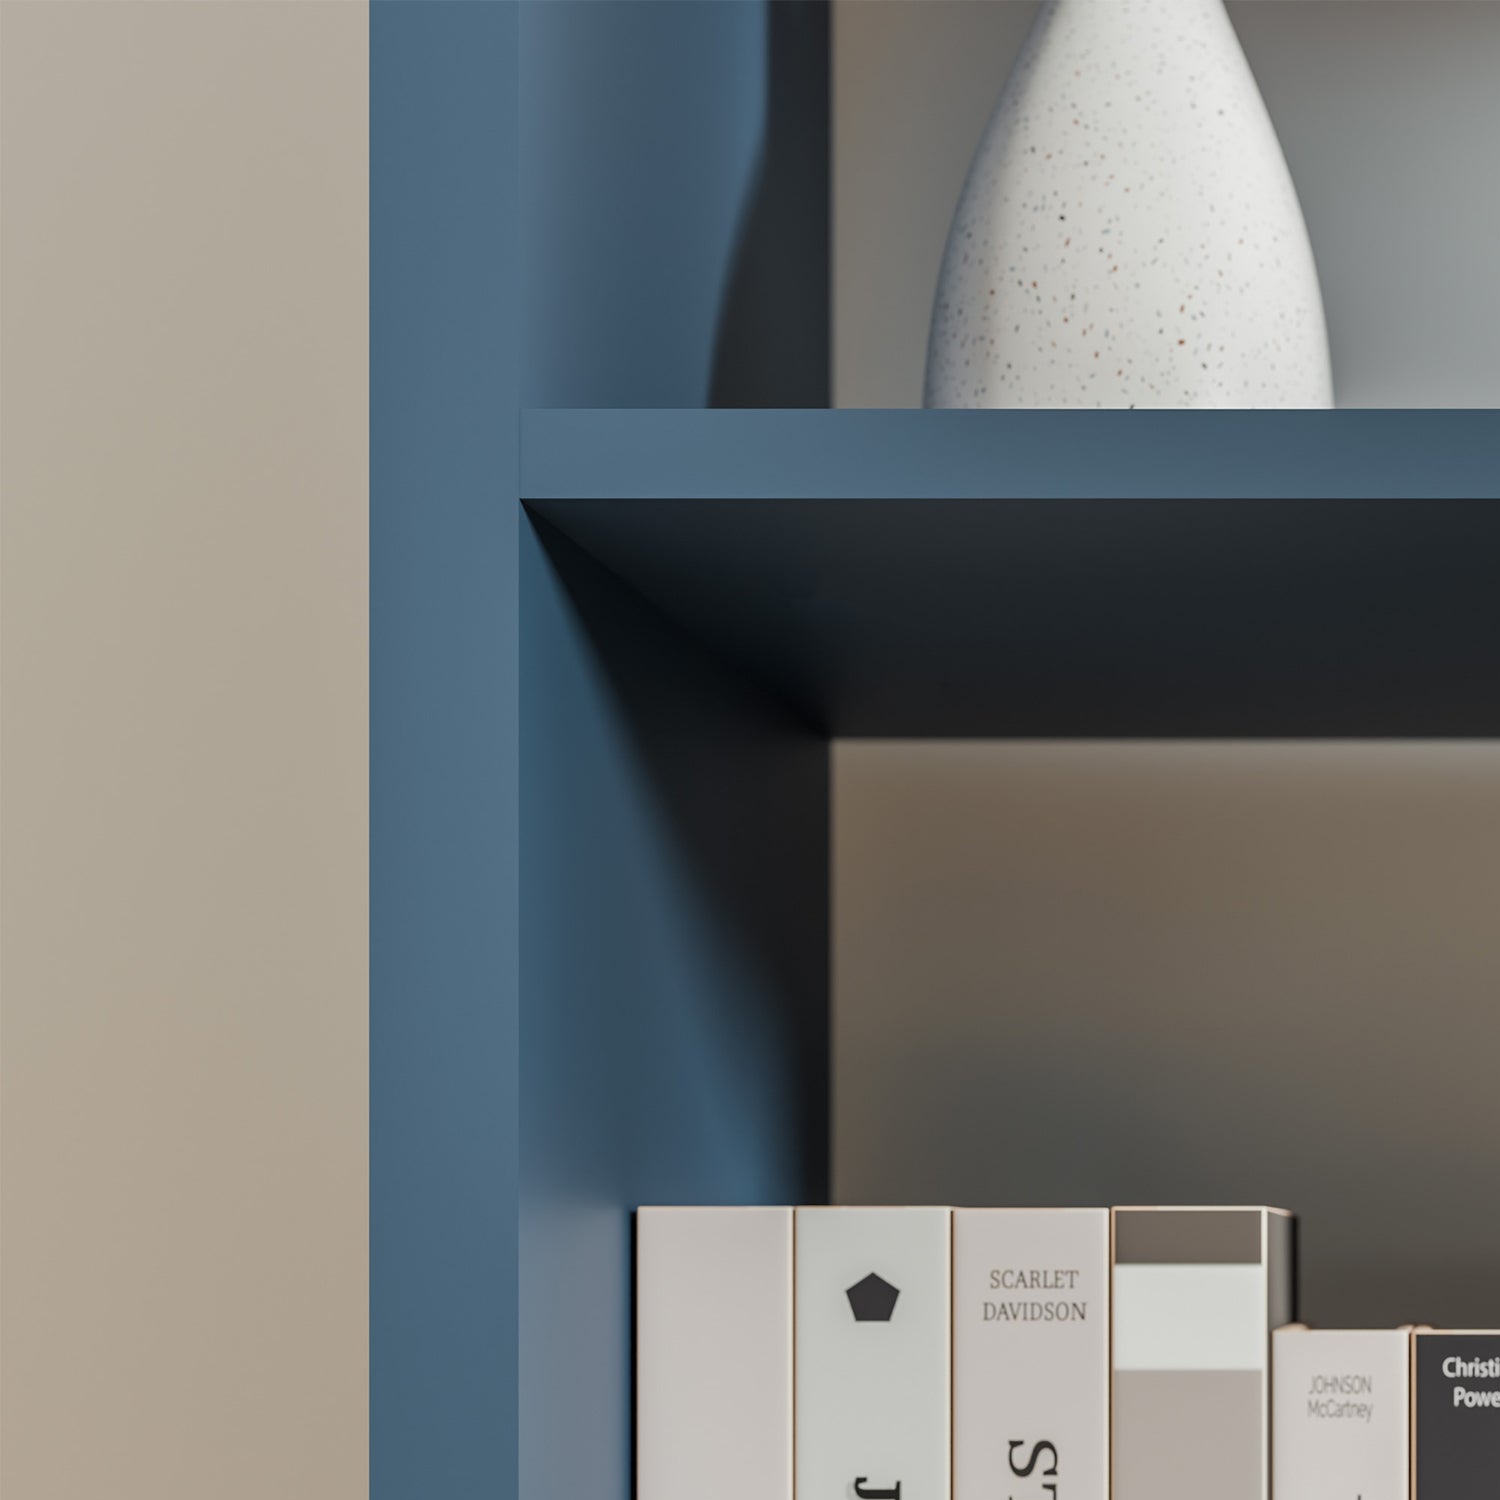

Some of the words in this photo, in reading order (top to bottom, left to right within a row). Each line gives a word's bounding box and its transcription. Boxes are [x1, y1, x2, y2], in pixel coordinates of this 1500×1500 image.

[989, 1269, 1080, 1290] SCARLET
[983, 1301, 1087, 1322] DAVIDSON
[1307, 1374, 1373, 1396] JOHNSON
[1307, 1398, 1374, 1424] McCartney
